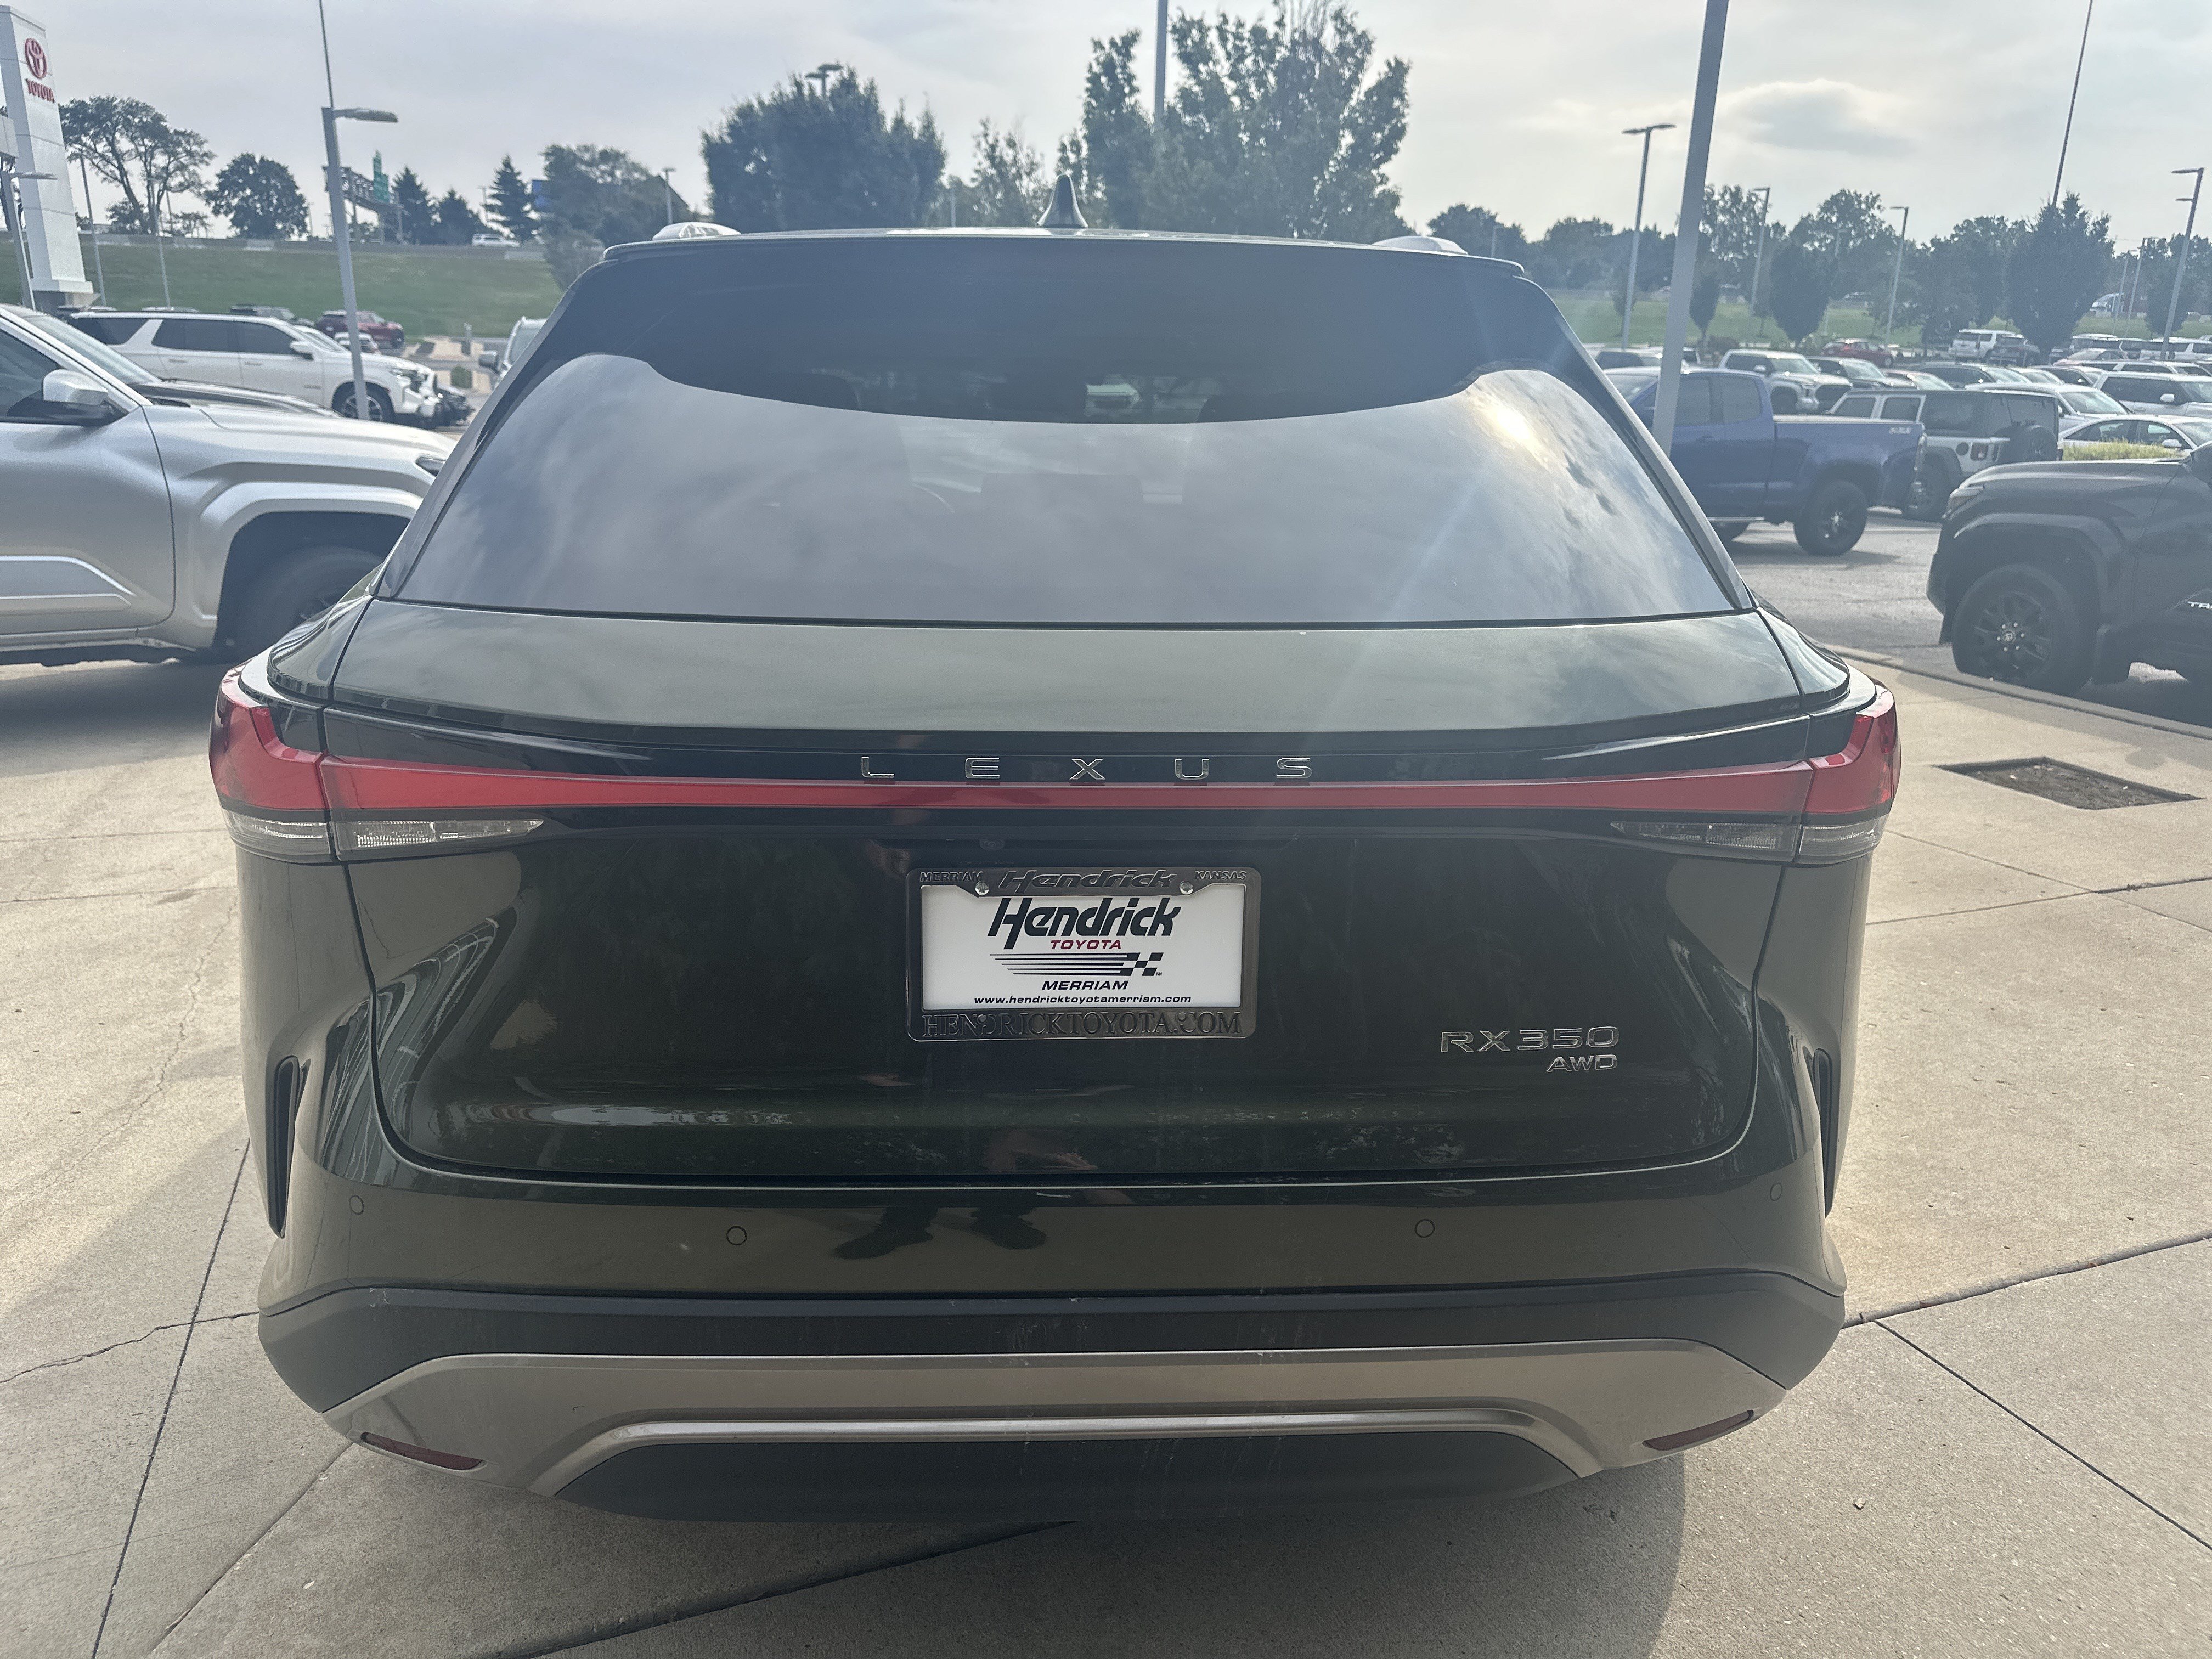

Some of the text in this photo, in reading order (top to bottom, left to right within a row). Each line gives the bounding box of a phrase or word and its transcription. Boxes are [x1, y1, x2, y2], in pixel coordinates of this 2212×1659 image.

[25, 78, 55, 103] TOYOTA
[861, 756, 1312, 781] LEXUS
[919, 871, 984, 882] MERRIAM
[997, 870, 1177, 894] Hendrick
[1194, 870, 1247, 881] KANSAS
[987, 897, 1181, 950] Hendrick
[1051, 940, 1122, 950] TOYOTA
[1041, 980, 1128, 991] MERRIAM
[974, 994, 1192, 1005] www.hendricktoyotamerriam.com
[922, 1011, 1242, 1037] HENDRICKTOYOTA.COM
[1547, 1054, 1618, 1073] AWD
